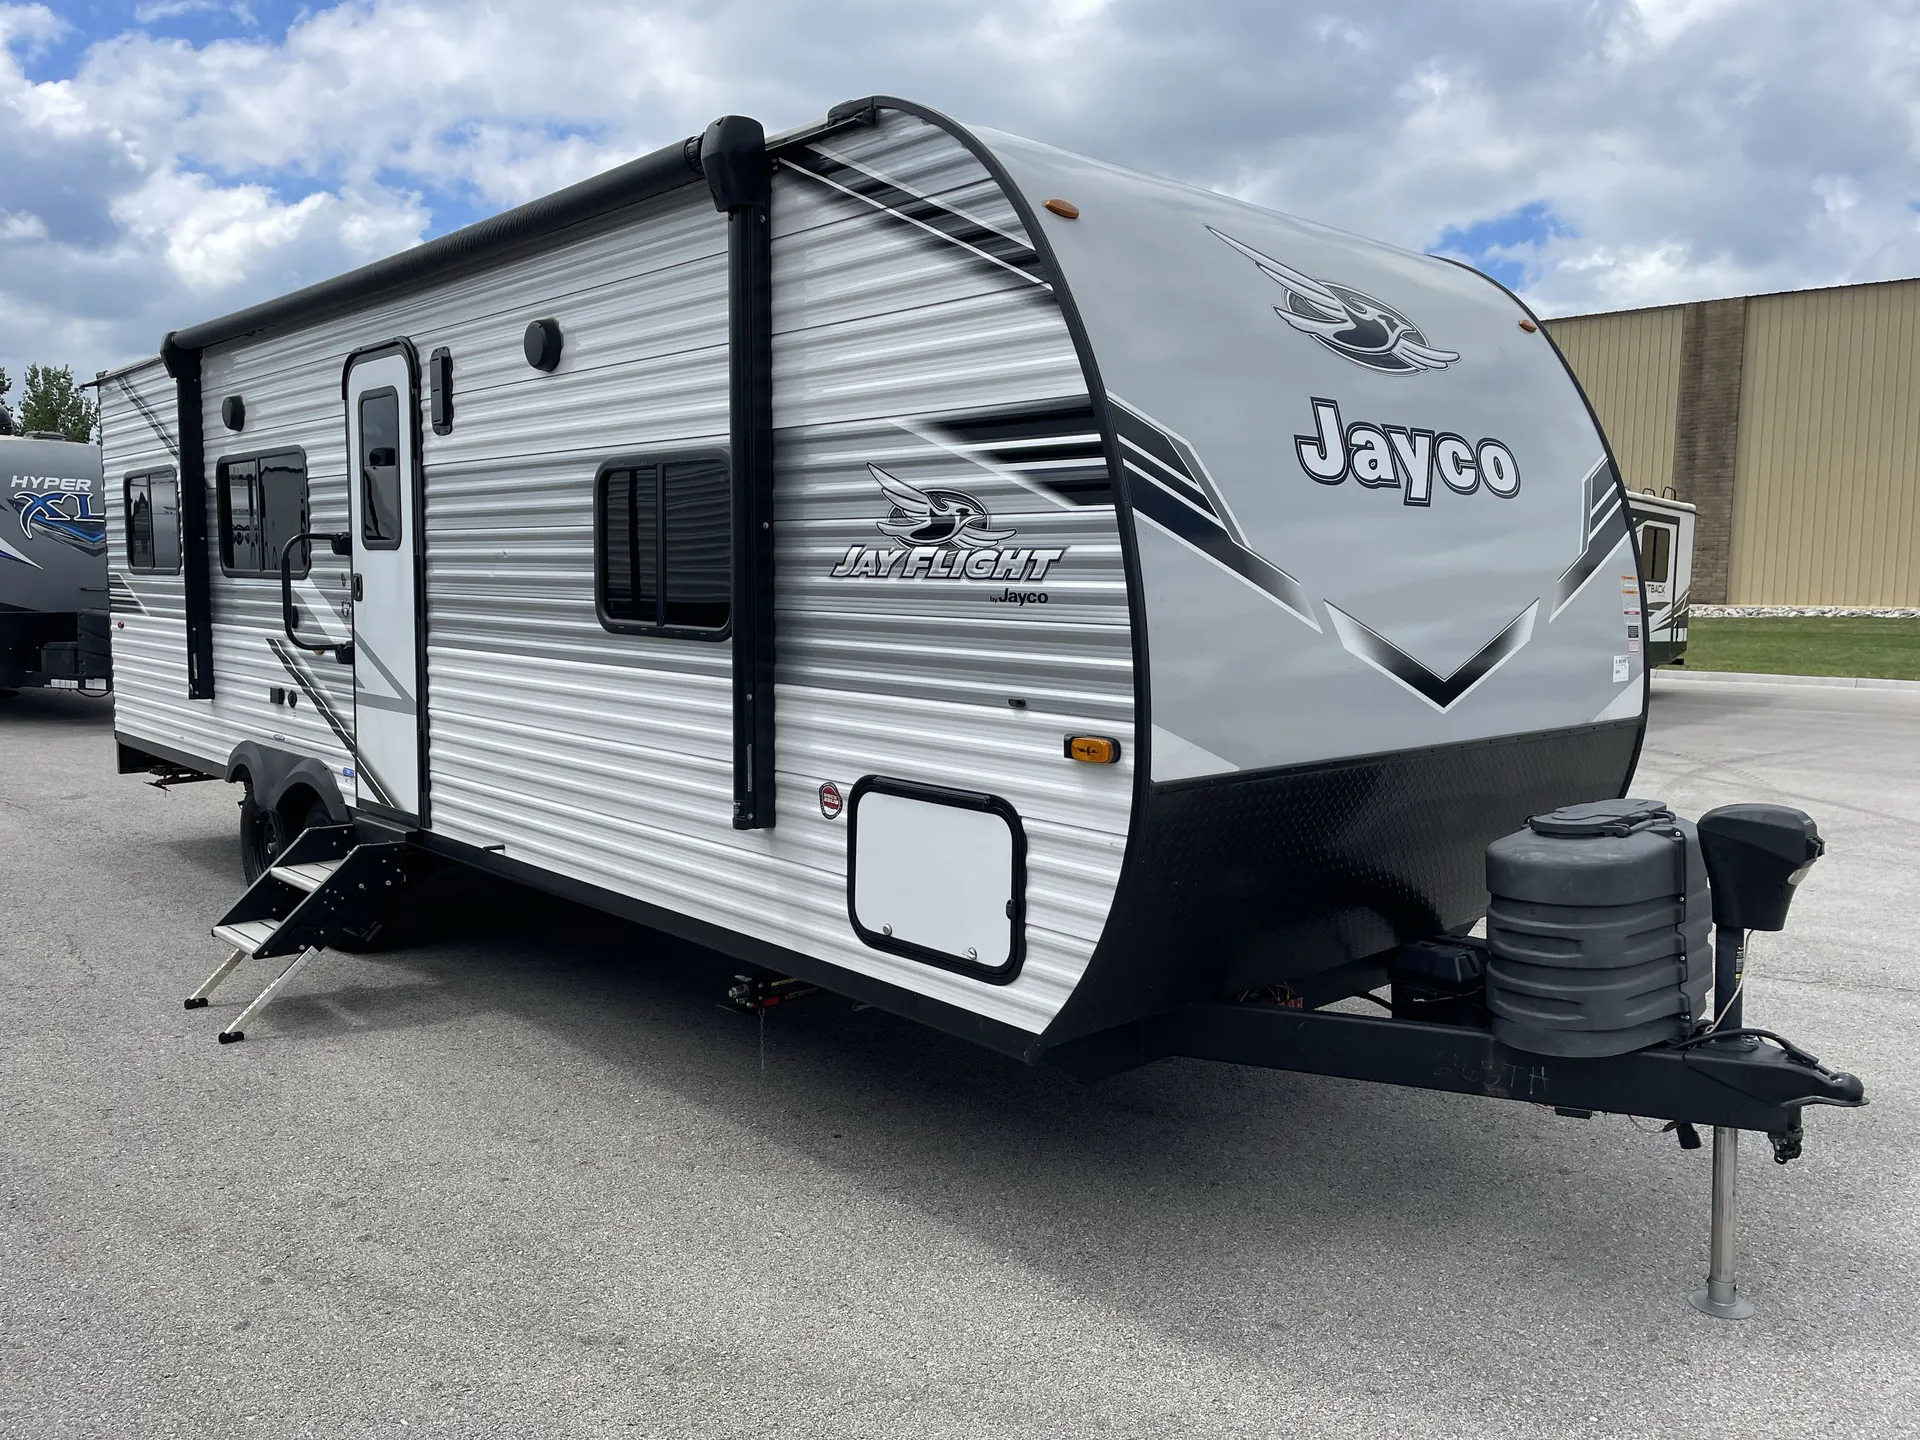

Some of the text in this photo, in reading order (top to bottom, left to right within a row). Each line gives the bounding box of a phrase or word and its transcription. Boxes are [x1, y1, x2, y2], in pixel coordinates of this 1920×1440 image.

[1294, 397, 1521, 507] Jayco
[10, 475, 92, 491] HYPER
[989, 588, 1049, 607] by Jayco
